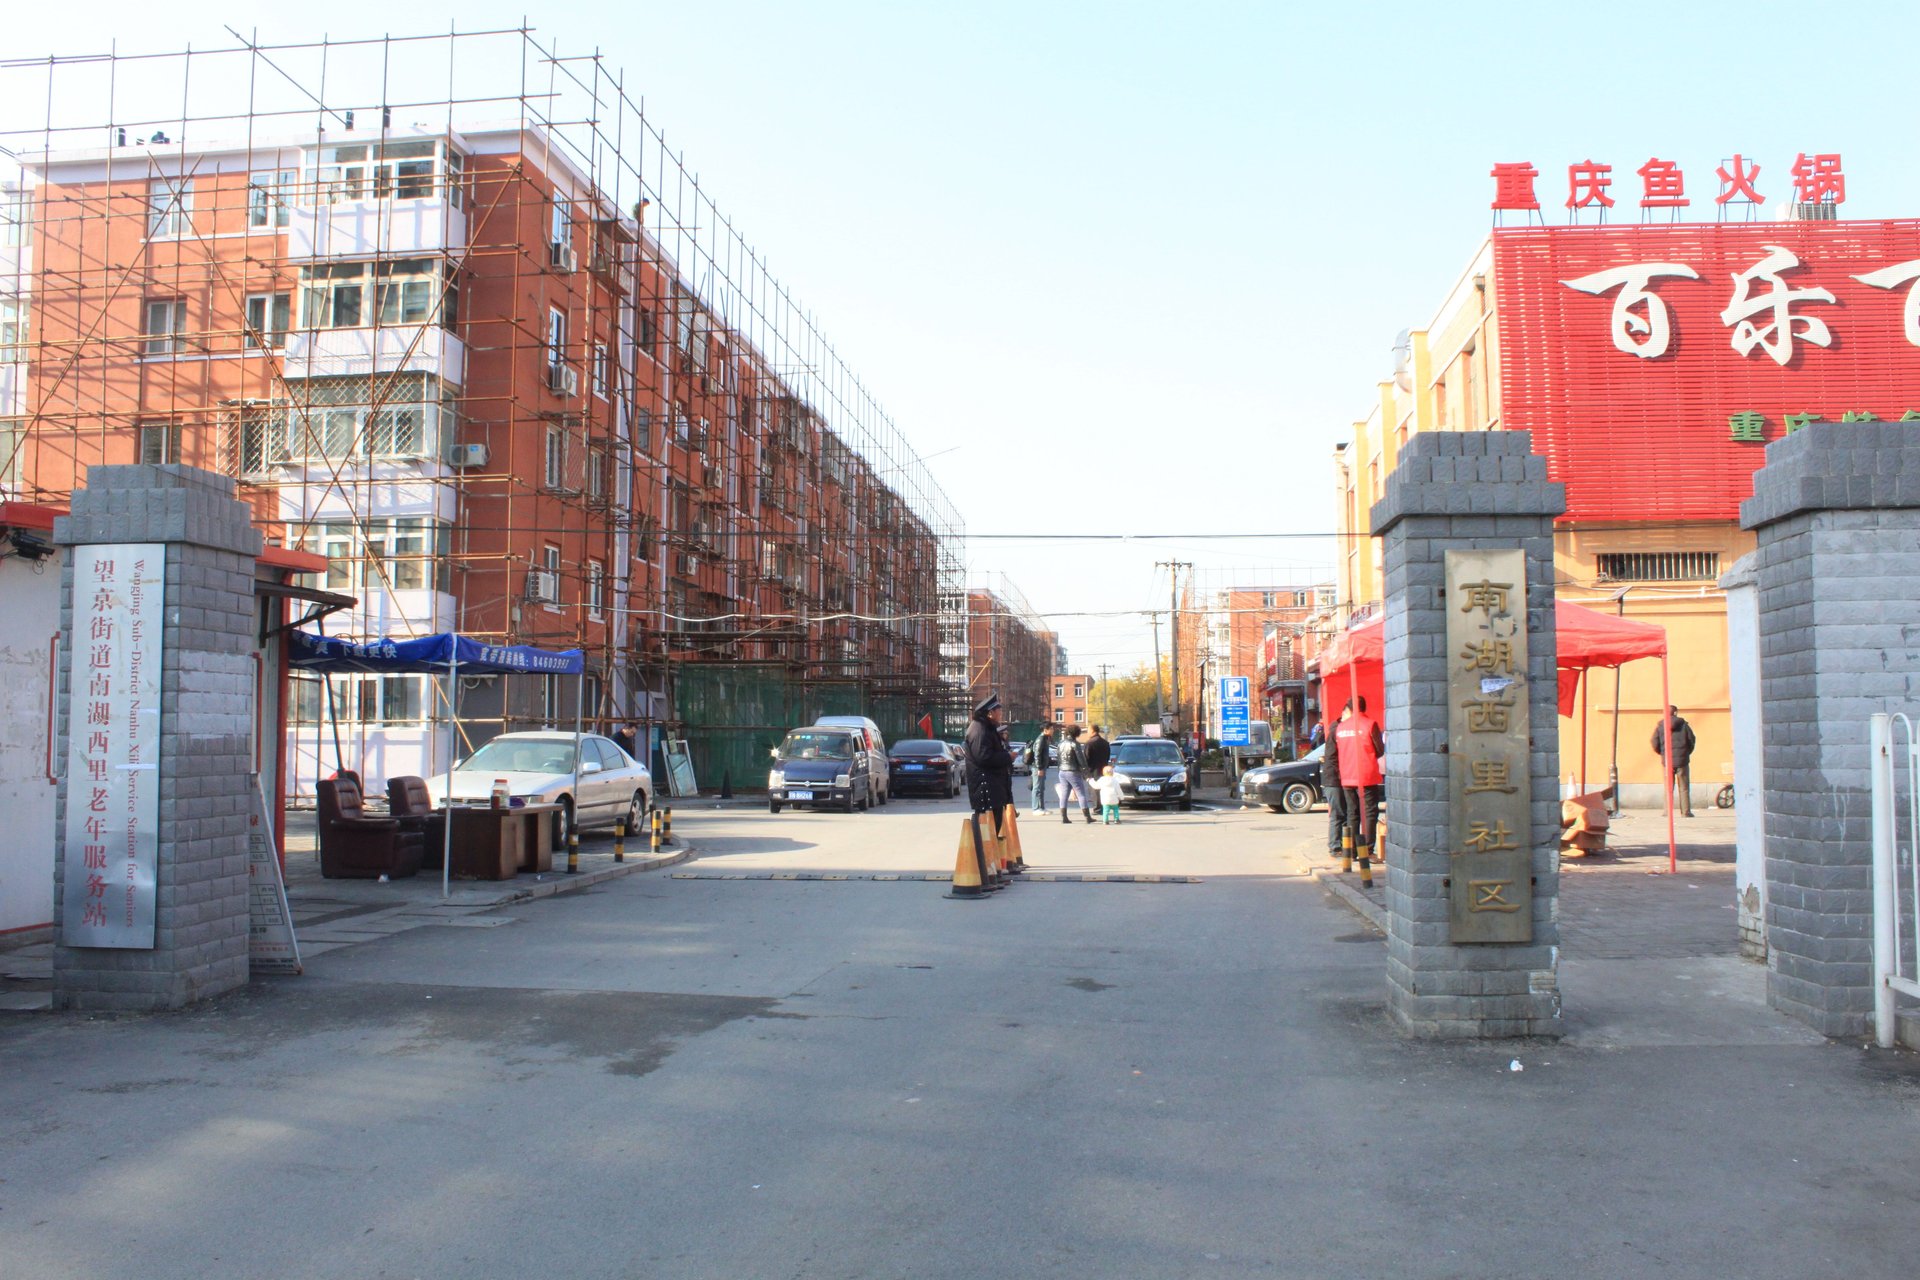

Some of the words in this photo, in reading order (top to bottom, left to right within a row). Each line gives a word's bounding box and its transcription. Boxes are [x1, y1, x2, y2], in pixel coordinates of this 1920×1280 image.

[1490, 153, 1846, 209] 重庆鱼火锅
[129, 559, 145, 616] Wangjing
[129, 620, 143, 695] Sub-District
[129, 700, 141, 739] Nanhu
[82, 559, 115, 928] 望京街道南湖西里老年服务站
[128, 744, 140, 764] Xili
[1459, 579, 1521, 913] 南湖西里社区
[128, 769, 139, 812] Service
[127, 817, 138, 859] Station
[126, 862, 138, 881] for
[126, 885, 137, 928] Seniors
